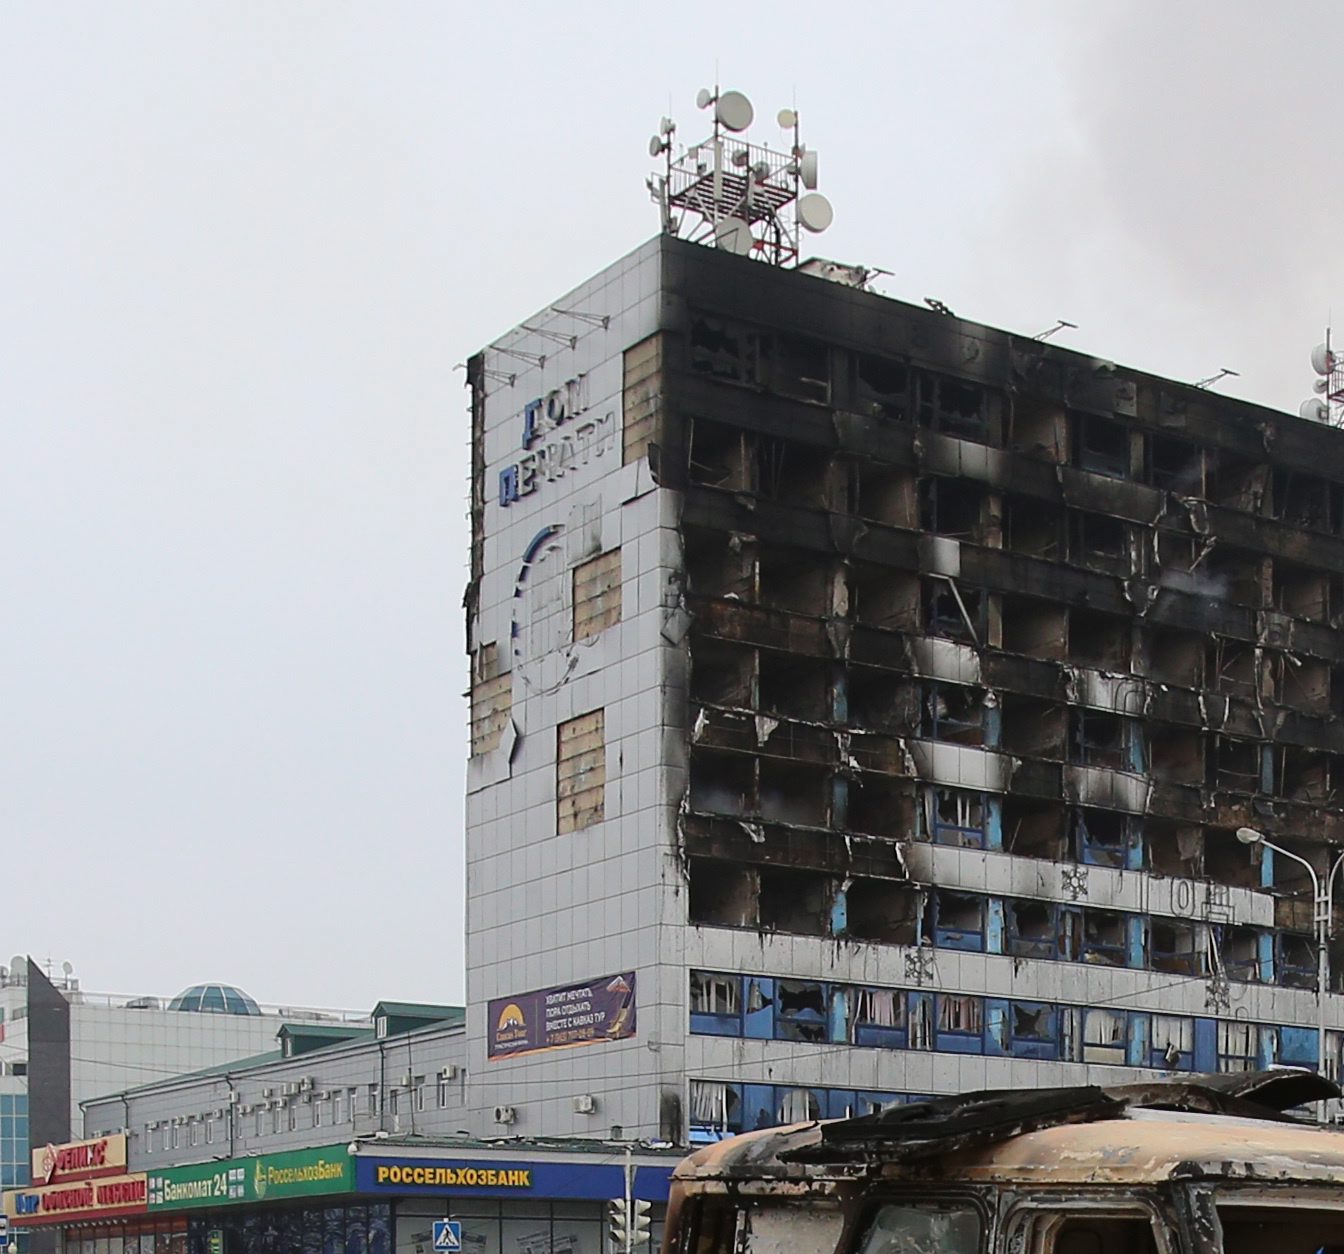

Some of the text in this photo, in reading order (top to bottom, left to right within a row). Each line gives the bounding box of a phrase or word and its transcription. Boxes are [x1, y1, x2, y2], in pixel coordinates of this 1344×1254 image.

[522, 373, 591, 449] ДОМ
[499, 410, 616, 507] ПЕЧАТИ
[163, 1172, 227, 1201] Банкомат 24
[267, 1160, 343, 1185] РоссельхозБанк
[377, 1165, 531, 1186] РОССЕЛЬХОЗБАНК
